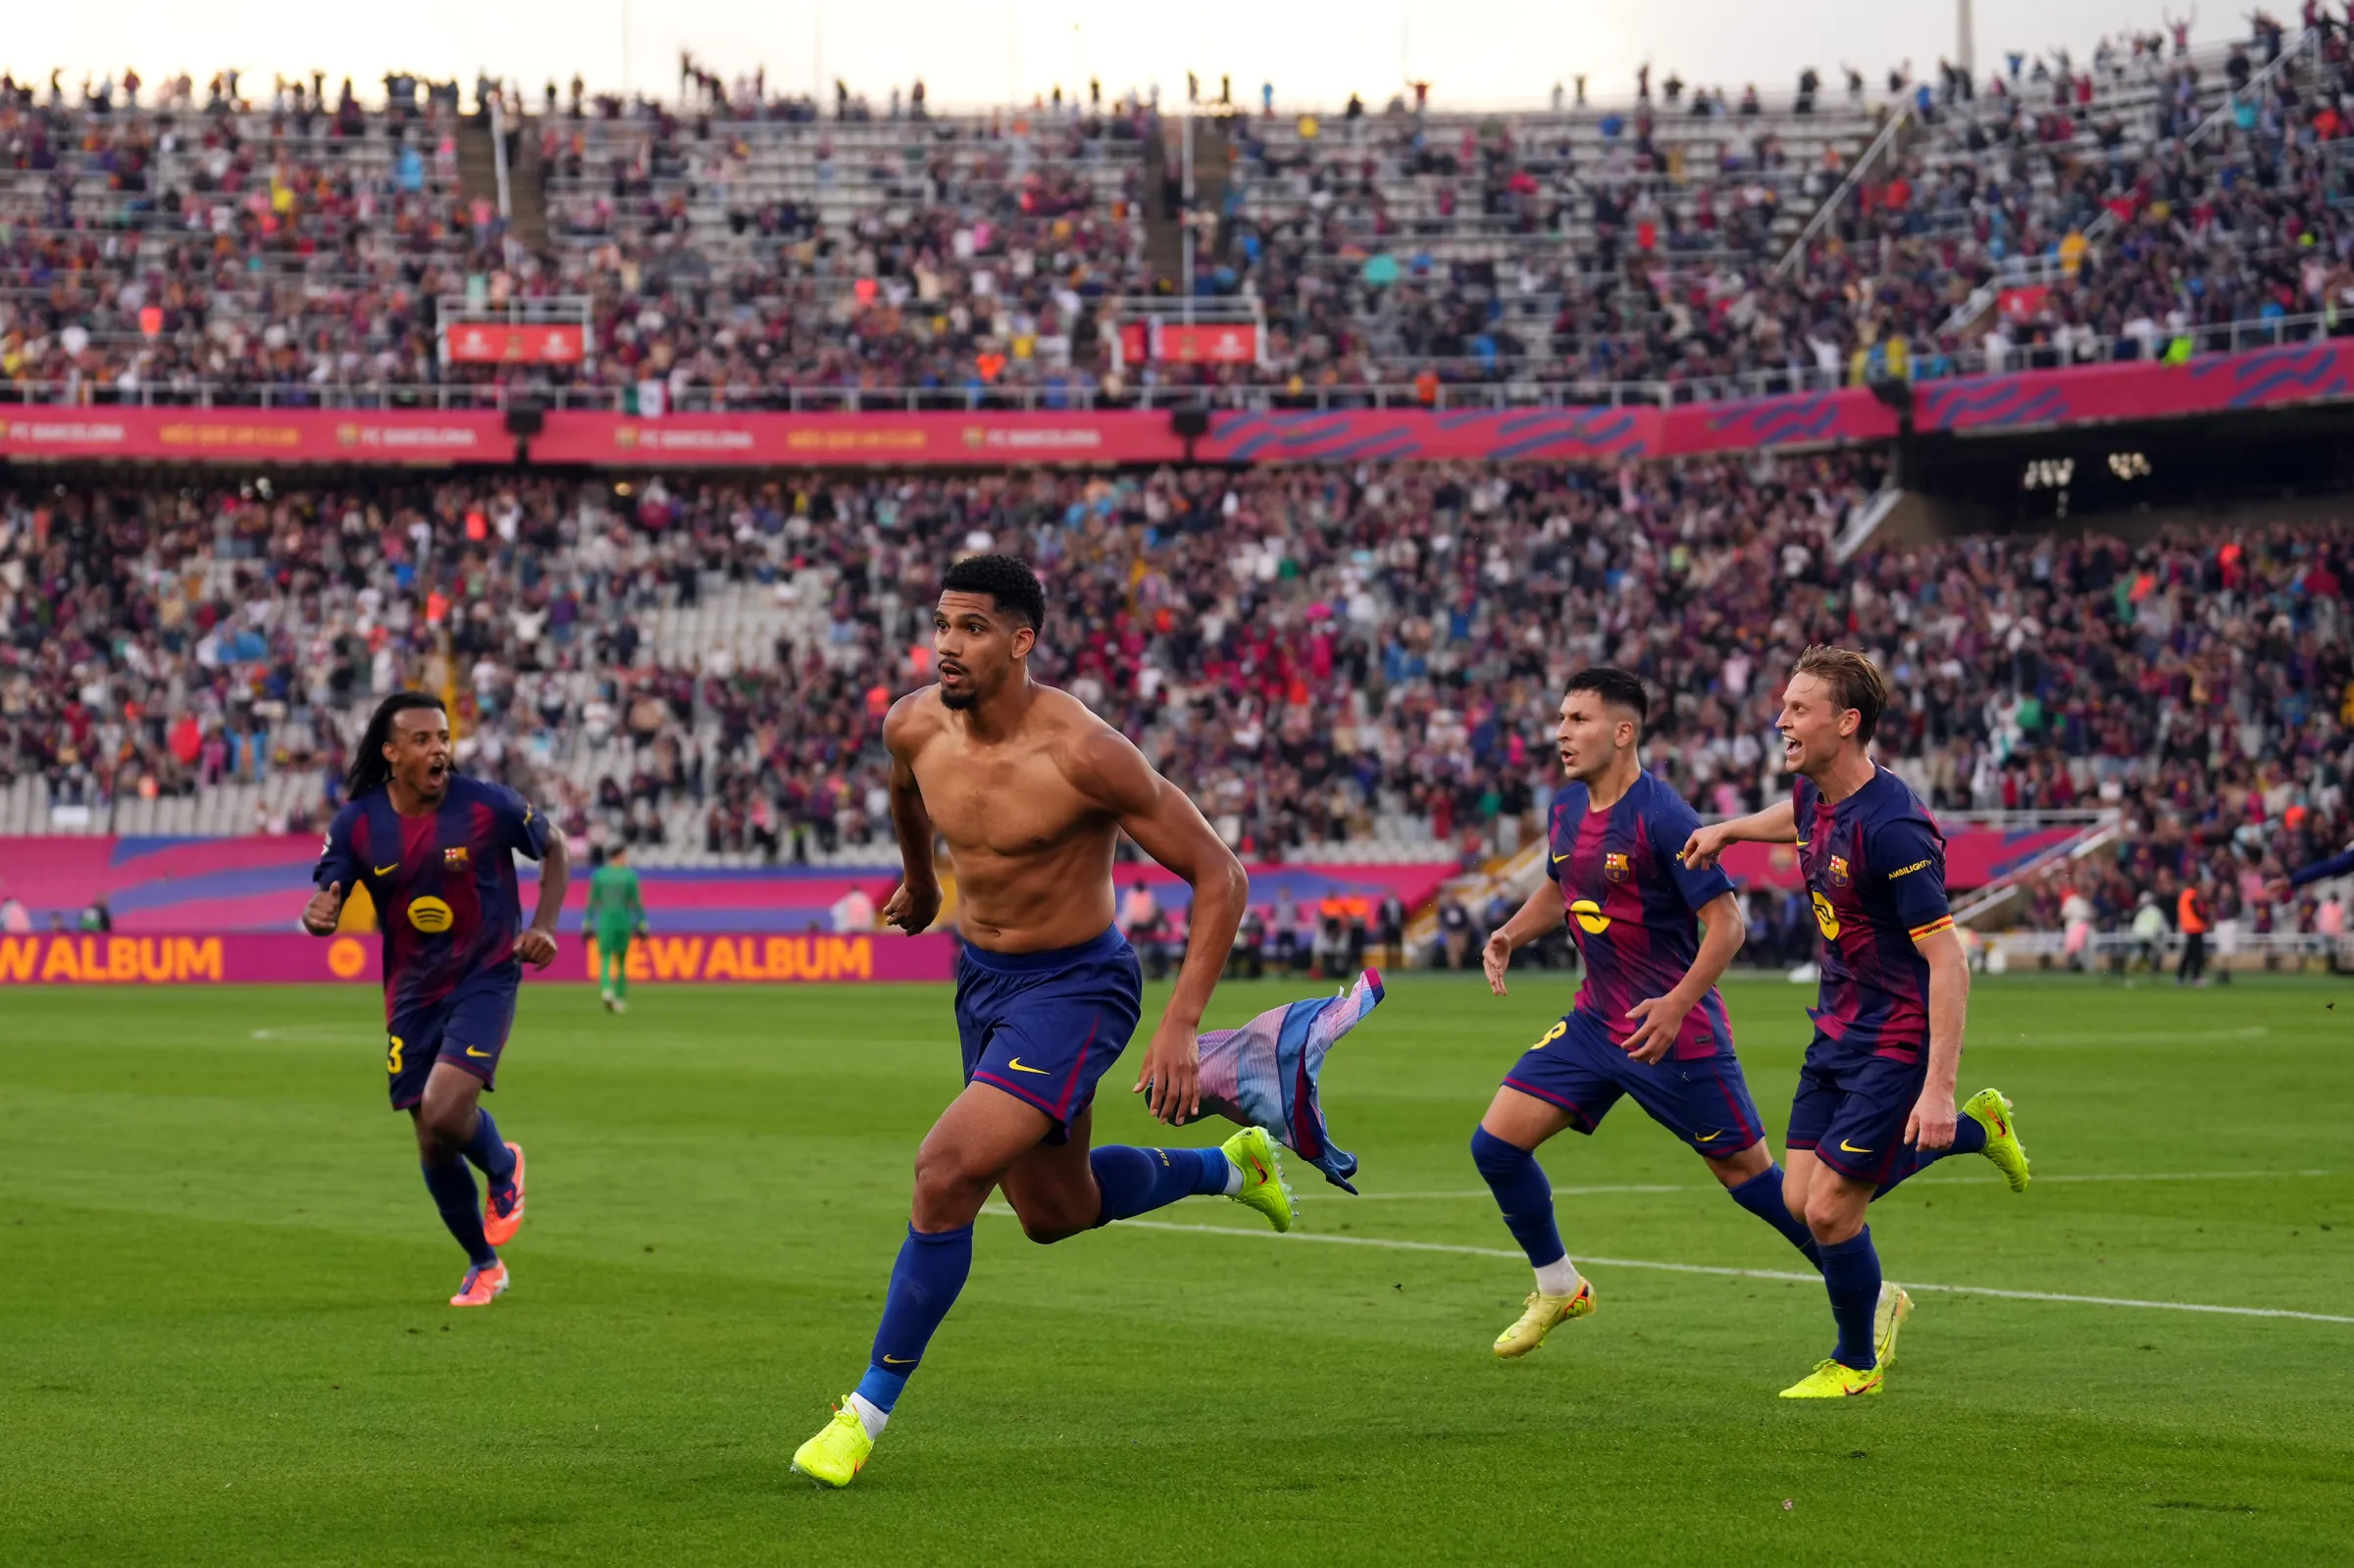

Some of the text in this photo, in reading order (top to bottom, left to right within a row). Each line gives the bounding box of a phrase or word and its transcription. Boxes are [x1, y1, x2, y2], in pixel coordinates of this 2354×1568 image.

[41, 936, 223, 981] ALBUM
[704, 936, 873, 980] ALBUM
[387, 1036, 403, 1075] 3
